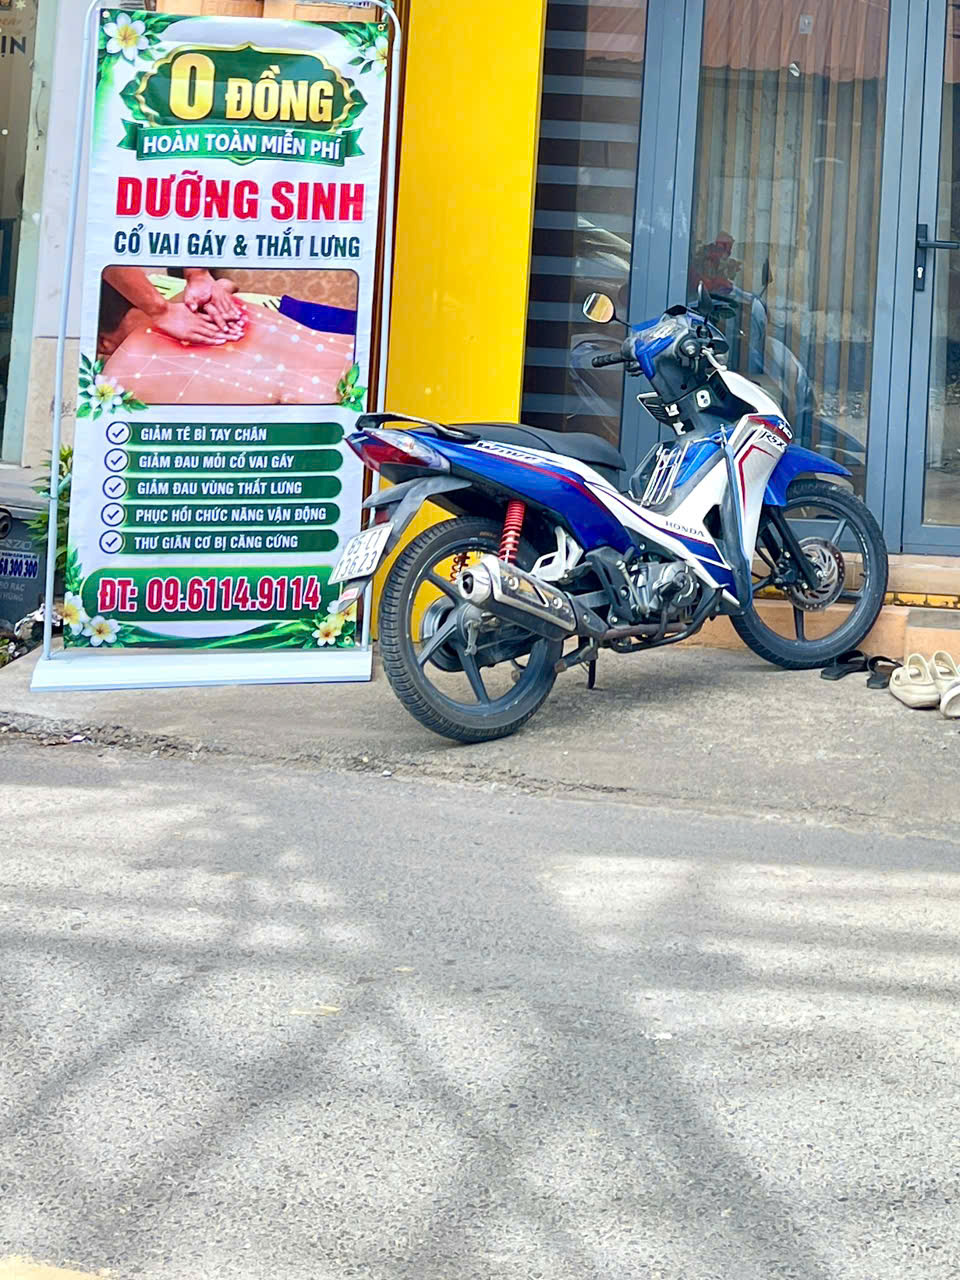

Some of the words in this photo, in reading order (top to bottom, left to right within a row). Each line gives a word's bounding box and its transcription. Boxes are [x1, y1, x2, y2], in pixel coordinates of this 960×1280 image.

[225, 65, 335, 123] ĐỒNG
[143, 130, 199, 154] HOÀN
[204, 129, 258, 154] TOÀN
[261, 129, 306, 157] MIỄN
[309, 137, 342, 160] PHÍ
[115, 170, 260, 220] DƯỠNG
[271, 180, 365, 222] SINH
[114, 223, 145, 254] CỔ
[148, 231, 180, 255] VAI
[187, 229, 227, 257] GÁY
[233, 234, 248, 257] &
[256, 227, 304, 258] THẮT
[309, 234, 360, 259] LƯNG
[140, 424, 172, 441] GIẢM
[176, 425, 191, 441] TÊ
[194, 426, 206, 441] BÌ
[210, 428, 231, 441] TAY
[234, 426, 267, 441] CHÂN
[138, 451, 171, 468] GIẢM
[174, 455, 199, 469] ĐAU
[202, 452, 226, 468] MỎI
[249, 455, 268, 469] VAI
[271, 452, 295, 469] GÁY
[137, 478, 169, 495] GIẢM
[172, 481, 198, 495] ĐAU
[201, 479, 234, 495] VÙNG
[237, 477, 267, 495] THẮT
[270, 480, 303, 495] LƯNG
[135, 508, 168, 524] PHỤC
[195, 505, 228, 522] CHỨC
[231, 506, 264, 522] NĂNG
[267, 506, 291, 524] VẬN
[294, 506, 327, 524] ĐỘNG
[664, 519, 706, 538] HONDA
[134, 535, 160, 550] THƯ
[162, 533, 191, 550] GIÃN
[194, 535, 211, 549] CƠ
[214, 536, 226, 551] BỊ
[230, 533, 263, 550] CĂNG
[265, 532, 298, 549] CỨNG
[98, 576, 137, 613] ĐT:
[145, 574, 321, 612] 09.6114.9114
